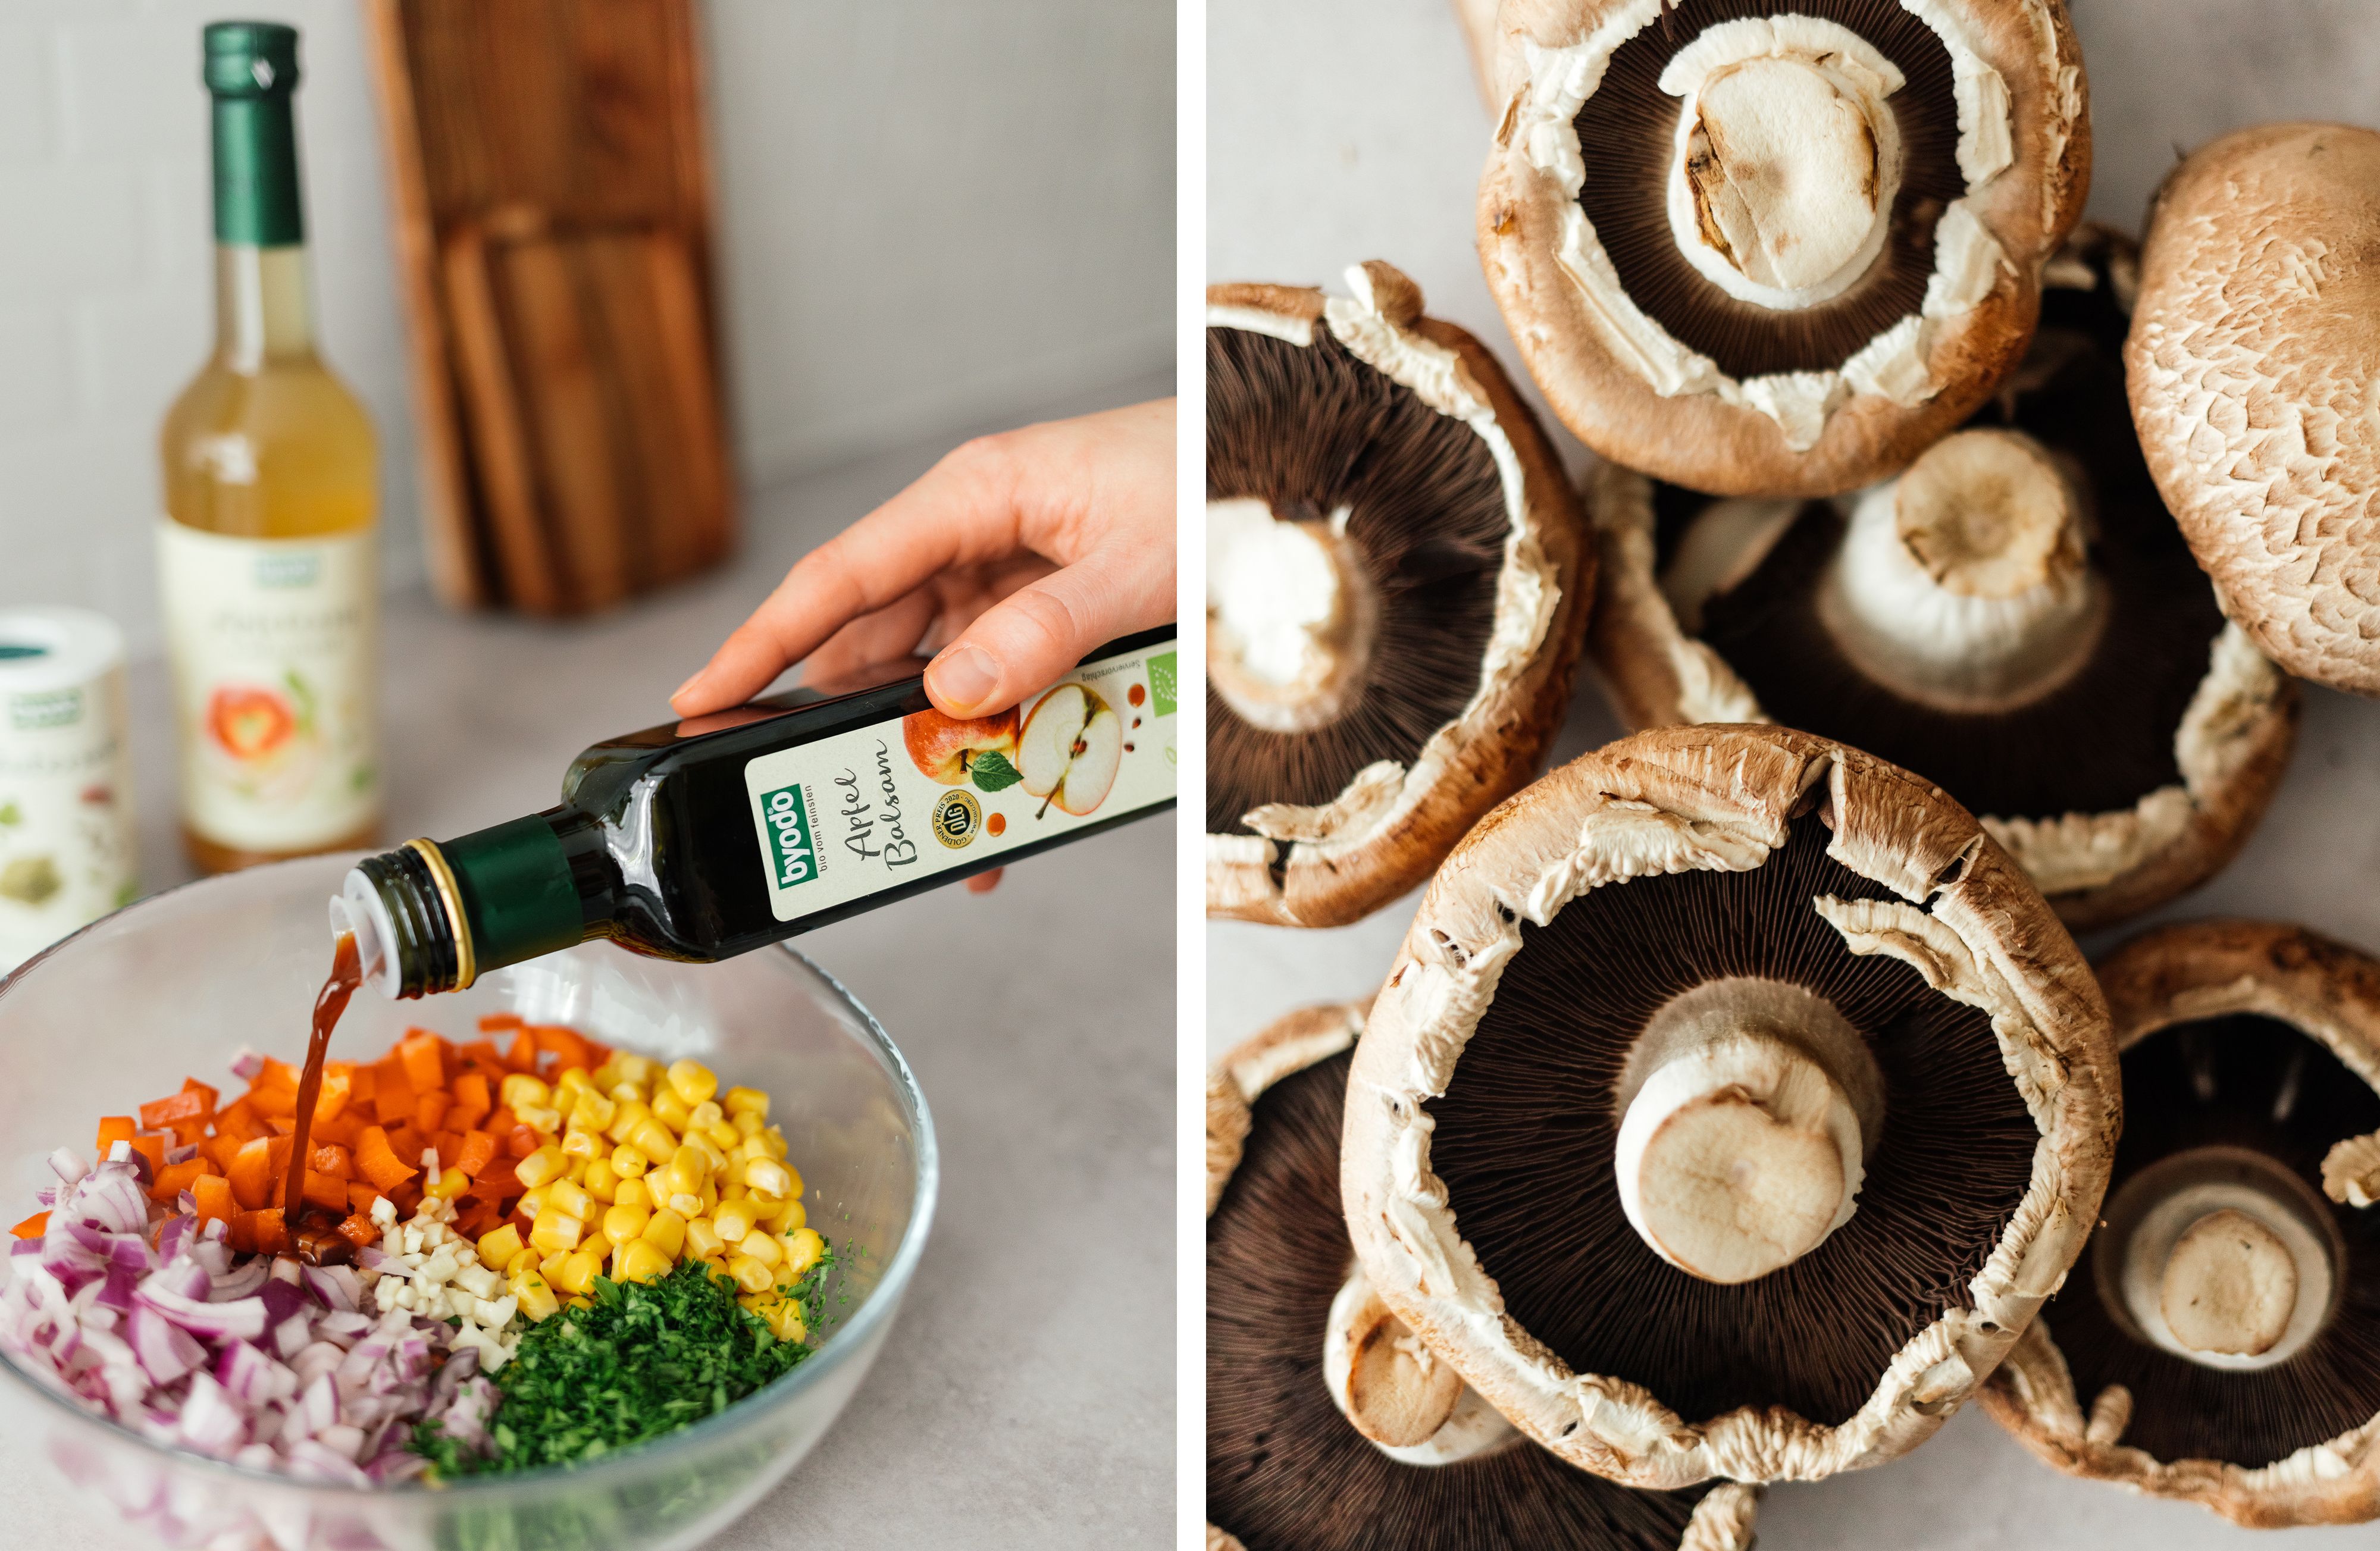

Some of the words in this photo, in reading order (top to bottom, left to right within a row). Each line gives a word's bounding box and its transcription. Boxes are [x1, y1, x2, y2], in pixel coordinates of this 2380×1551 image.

[1082, 660, 1141, 681] Serviervorschlag
[805, 785, 819, 828] feinsten
[876, 739, 917, 871] Balsam
[944, 794, 959, 804] 2020
[834, 768, 881, 861] Apfel
[935, 801, 945, 822] PREIS
[942, 806, 967, 832] DLG
[768, 791, 811, 885] byodo
[814, 831, 824, 853] vom
[936, 824, 967, 845] GOLDENER
[818, 856, 828, 872] bio
